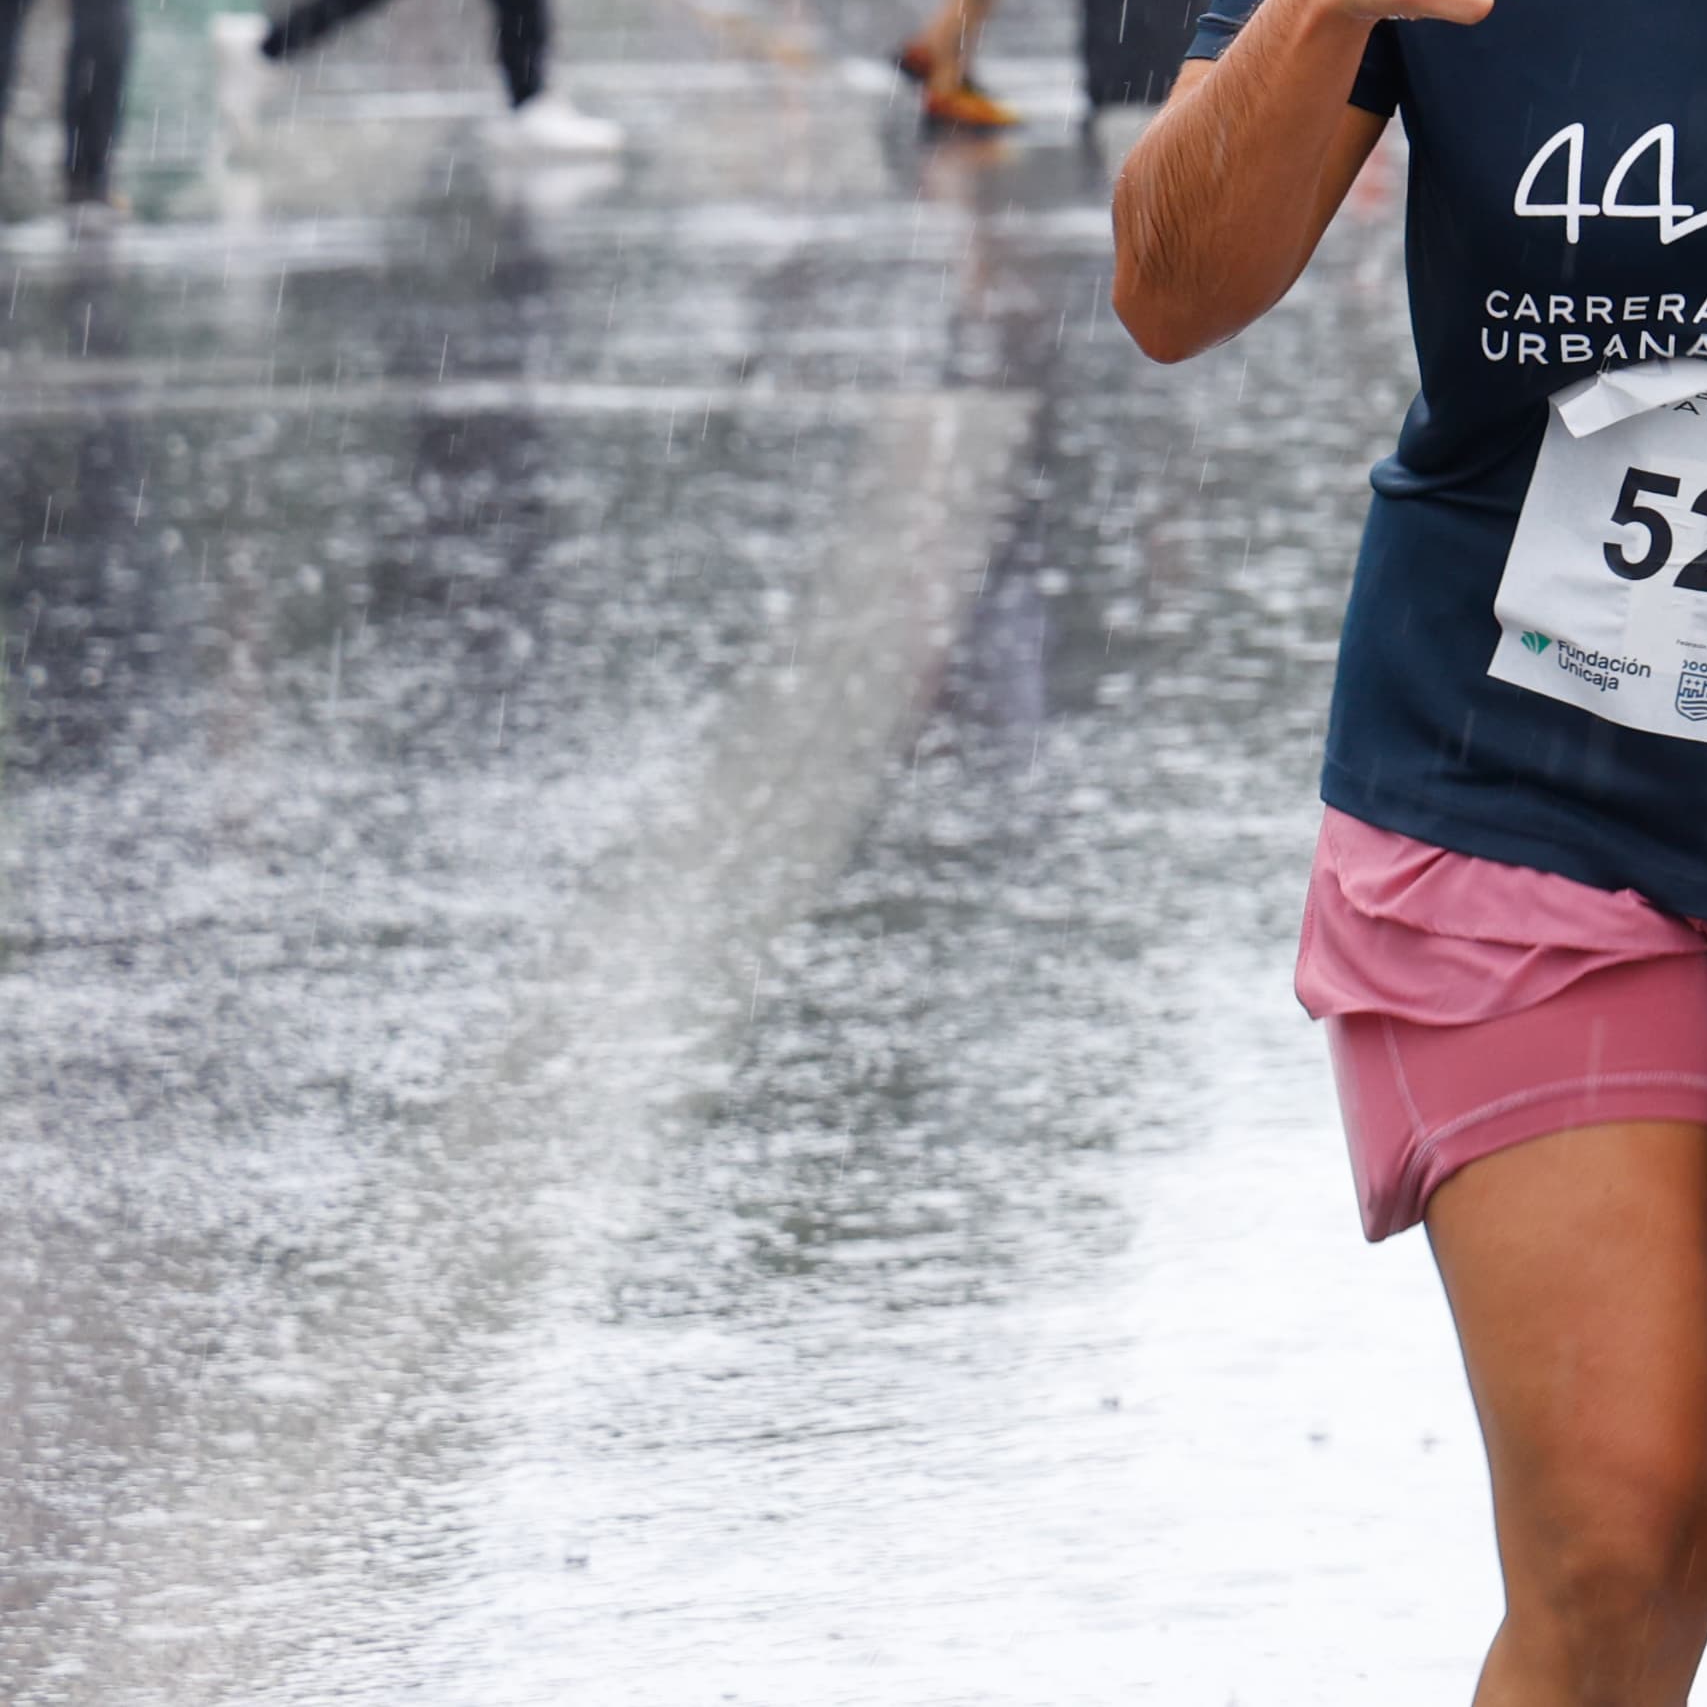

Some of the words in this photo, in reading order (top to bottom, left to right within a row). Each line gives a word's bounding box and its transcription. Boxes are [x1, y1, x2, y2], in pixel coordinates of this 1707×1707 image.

[1513, 122, 1695, 245] 44
[1557, 639, 1652, 679] Fundación
[1558, 653, 1620, 692] Unicaja
